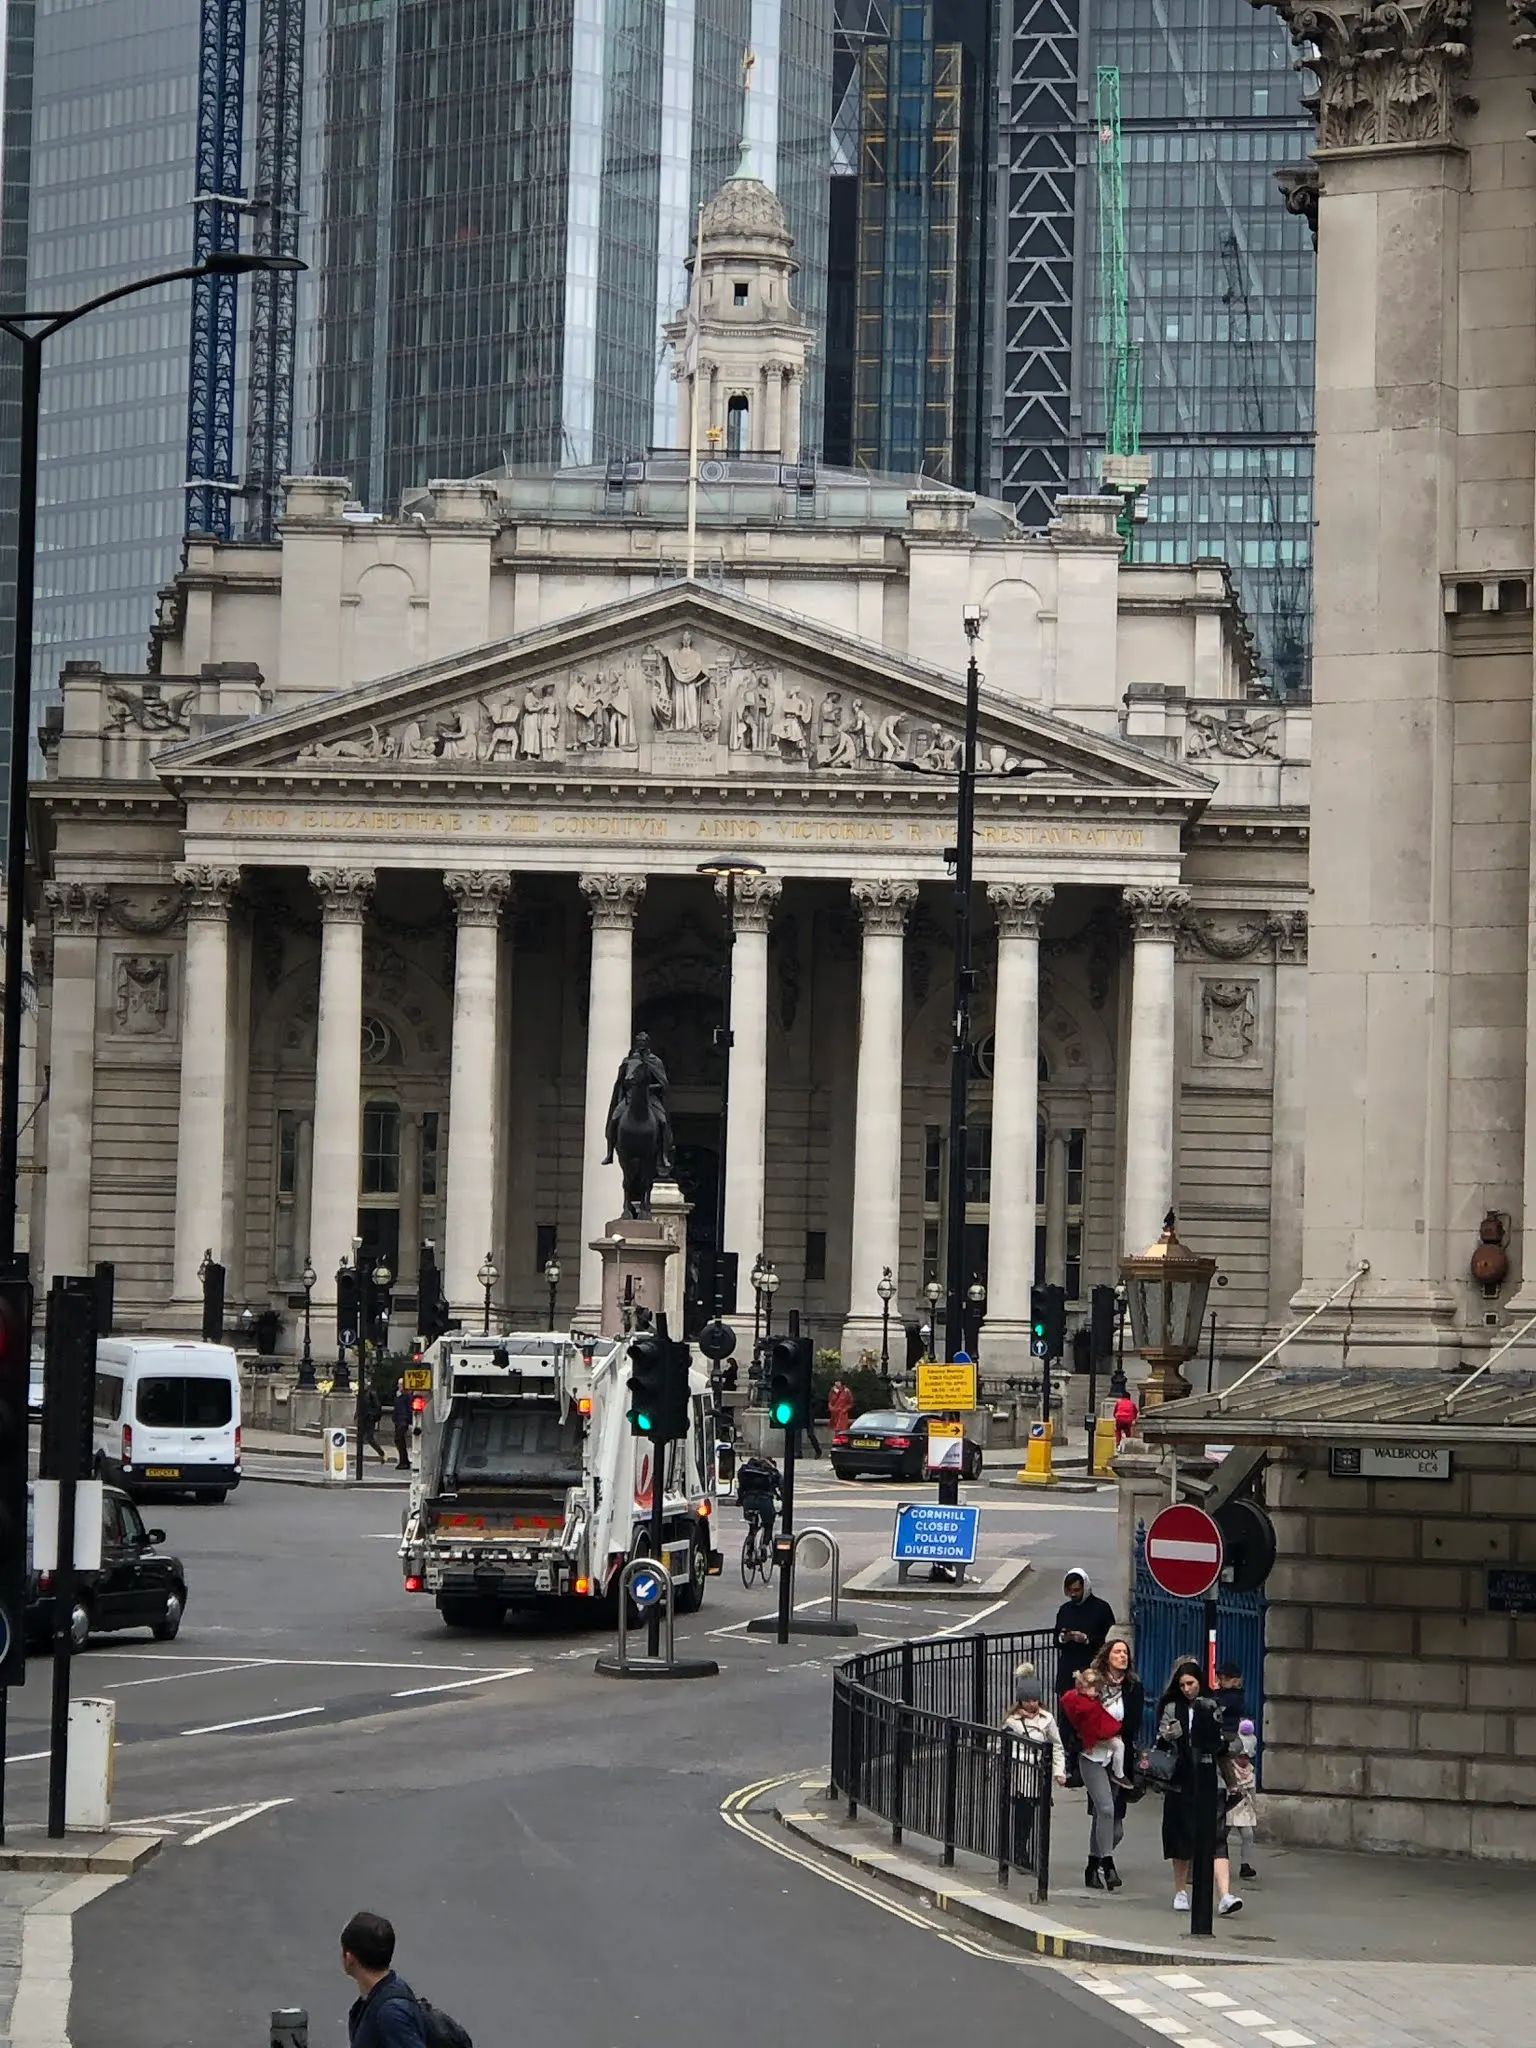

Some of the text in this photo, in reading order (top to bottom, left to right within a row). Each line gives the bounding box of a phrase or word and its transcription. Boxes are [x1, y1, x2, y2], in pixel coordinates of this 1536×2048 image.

[223, 809, 287, 827] ANNO
[304, 811, 462, 831] ELIZABETHAE
[477, 814, 491, 831] R
[552, 816, 667, 837] CONDITVM
[696, 820, 761, 838] ANNO
[777, 821, 895, 841] VICTORIAE
[907, 824, 922, 841] R
[984, 825, 1146, 848] RESTAVRATVM
[1374, 1448, 1439, 1460] WALBROOK
[1418, 1462, 1439, 1473] EC4
[910, 1509, 966, 1521] CORNHILL
[915, 1521, 959, 1532] CLOSED
[914, 1533, 958, 1544] FOLLOW
[904, 1545, 964, 1556] DIVERSION
